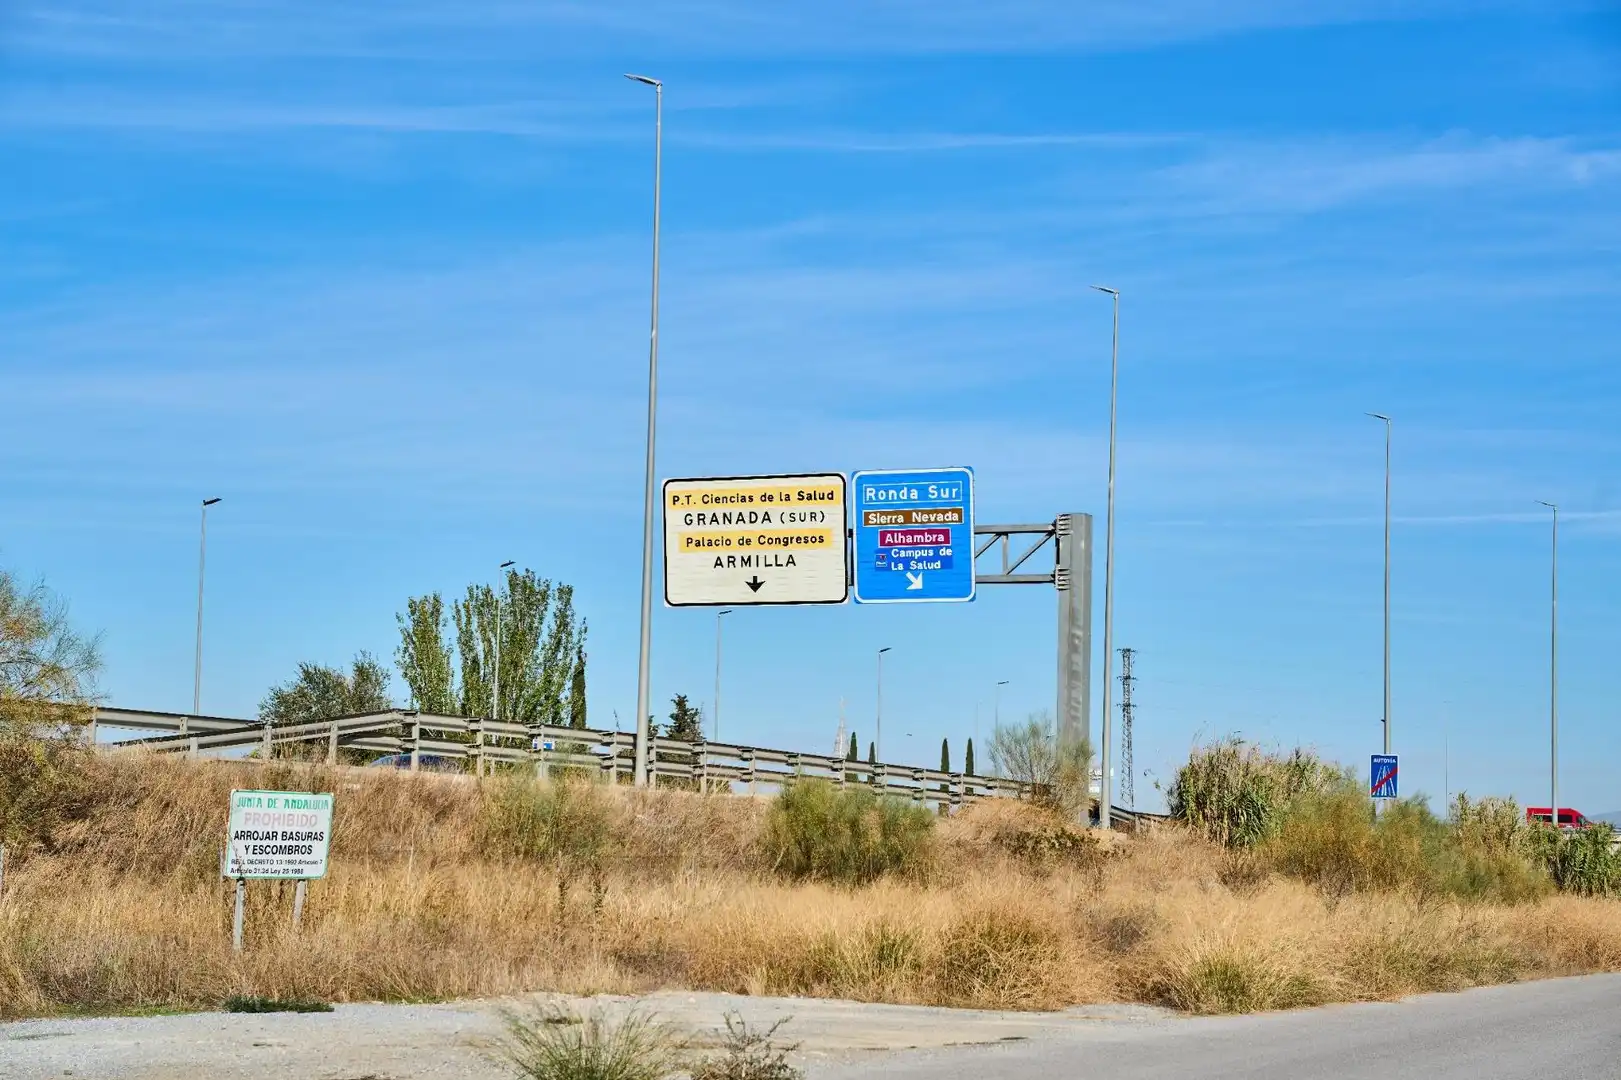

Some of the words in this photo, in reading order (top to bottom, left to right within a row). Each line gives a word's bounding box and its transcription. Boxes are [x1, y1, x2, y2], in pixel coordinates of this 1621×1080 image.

[672, 495, 696, 505] P.T.
[702, 493, 753, 504] Ciencias
[760, 492, 774, 502] de
[780, 491, 791, 501] la
[797, 490, 834, 501] Salud
[866, 486, 918, 501] Ronda
[928, 485, 958, 498] Sur
[684, 511, 772, 526] GRANADA
[780, 511, 825, 524] (SUR)
[868, 513, 904, 524] Sierra
[912, 511, 958, 522] Nevada
[686, 536, 731, 547] Palacio
[738, 536, 752, 546] de
[757, 534, 824, 546] Congresos
[885, 532, 944, 544] Alhambra
[891, 548, 934, 559] Campus
[939, 547, 952, 556] de
[713, 554, 796, 568] ARMILLA
[891, 562, 903, 571] La
[909, 561, 941, 570] Salud
[236, 797, 262, 808] JUNTA
[267, 798, 277, 808] DE
[244, 812, 317, 828] PROHIBIDO
[234, 830, 278, 841] ARROJAR
[281, 831, 324, 841] BASURAS
[244, 845, 250, 854] Y
[252, 845, 312, 855] ESCOMBROS
